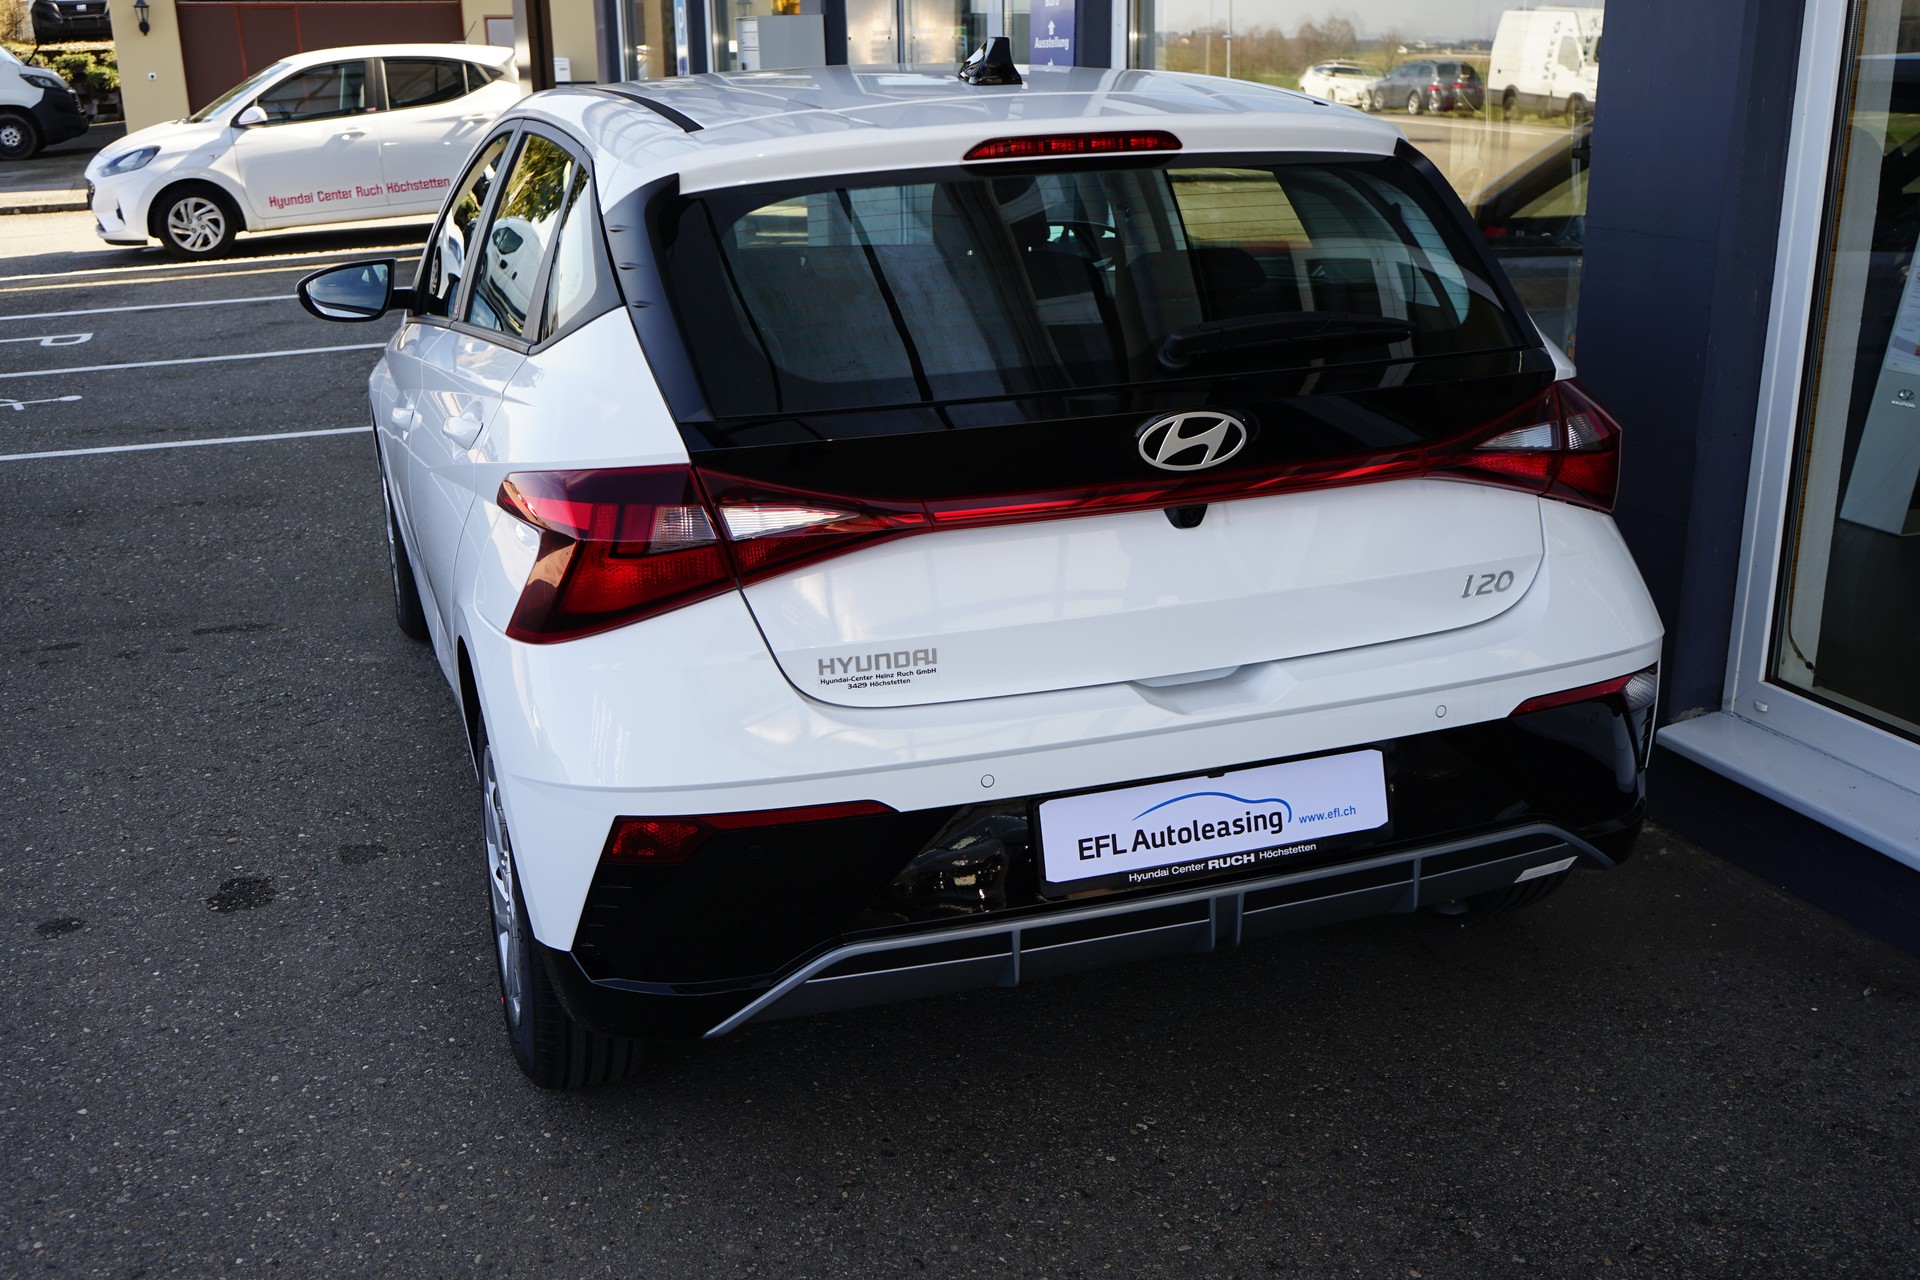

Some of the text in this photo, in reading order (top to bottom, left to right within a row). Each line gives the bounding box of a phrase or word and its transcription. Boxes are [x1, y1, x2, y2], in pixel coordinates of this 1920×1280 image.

[1034, 36, 1069, 51] Ausstellung
[269, 177, 451, 209] Hyundai Center Ruch Höchstetten
[818, 647, 938, 676] HYUNDAI
[820, 675, 873, 685] Hyundai-Center
[847, 679, 911, 690] 3429 Höchstetten
[1299, 805, 1357, 824] www.efl.ch
[1078, 811, 1283, 861] EFL Autoleasing
[1128, 843, 1317, 883] Hyundai Center RUCH Höchstetten
